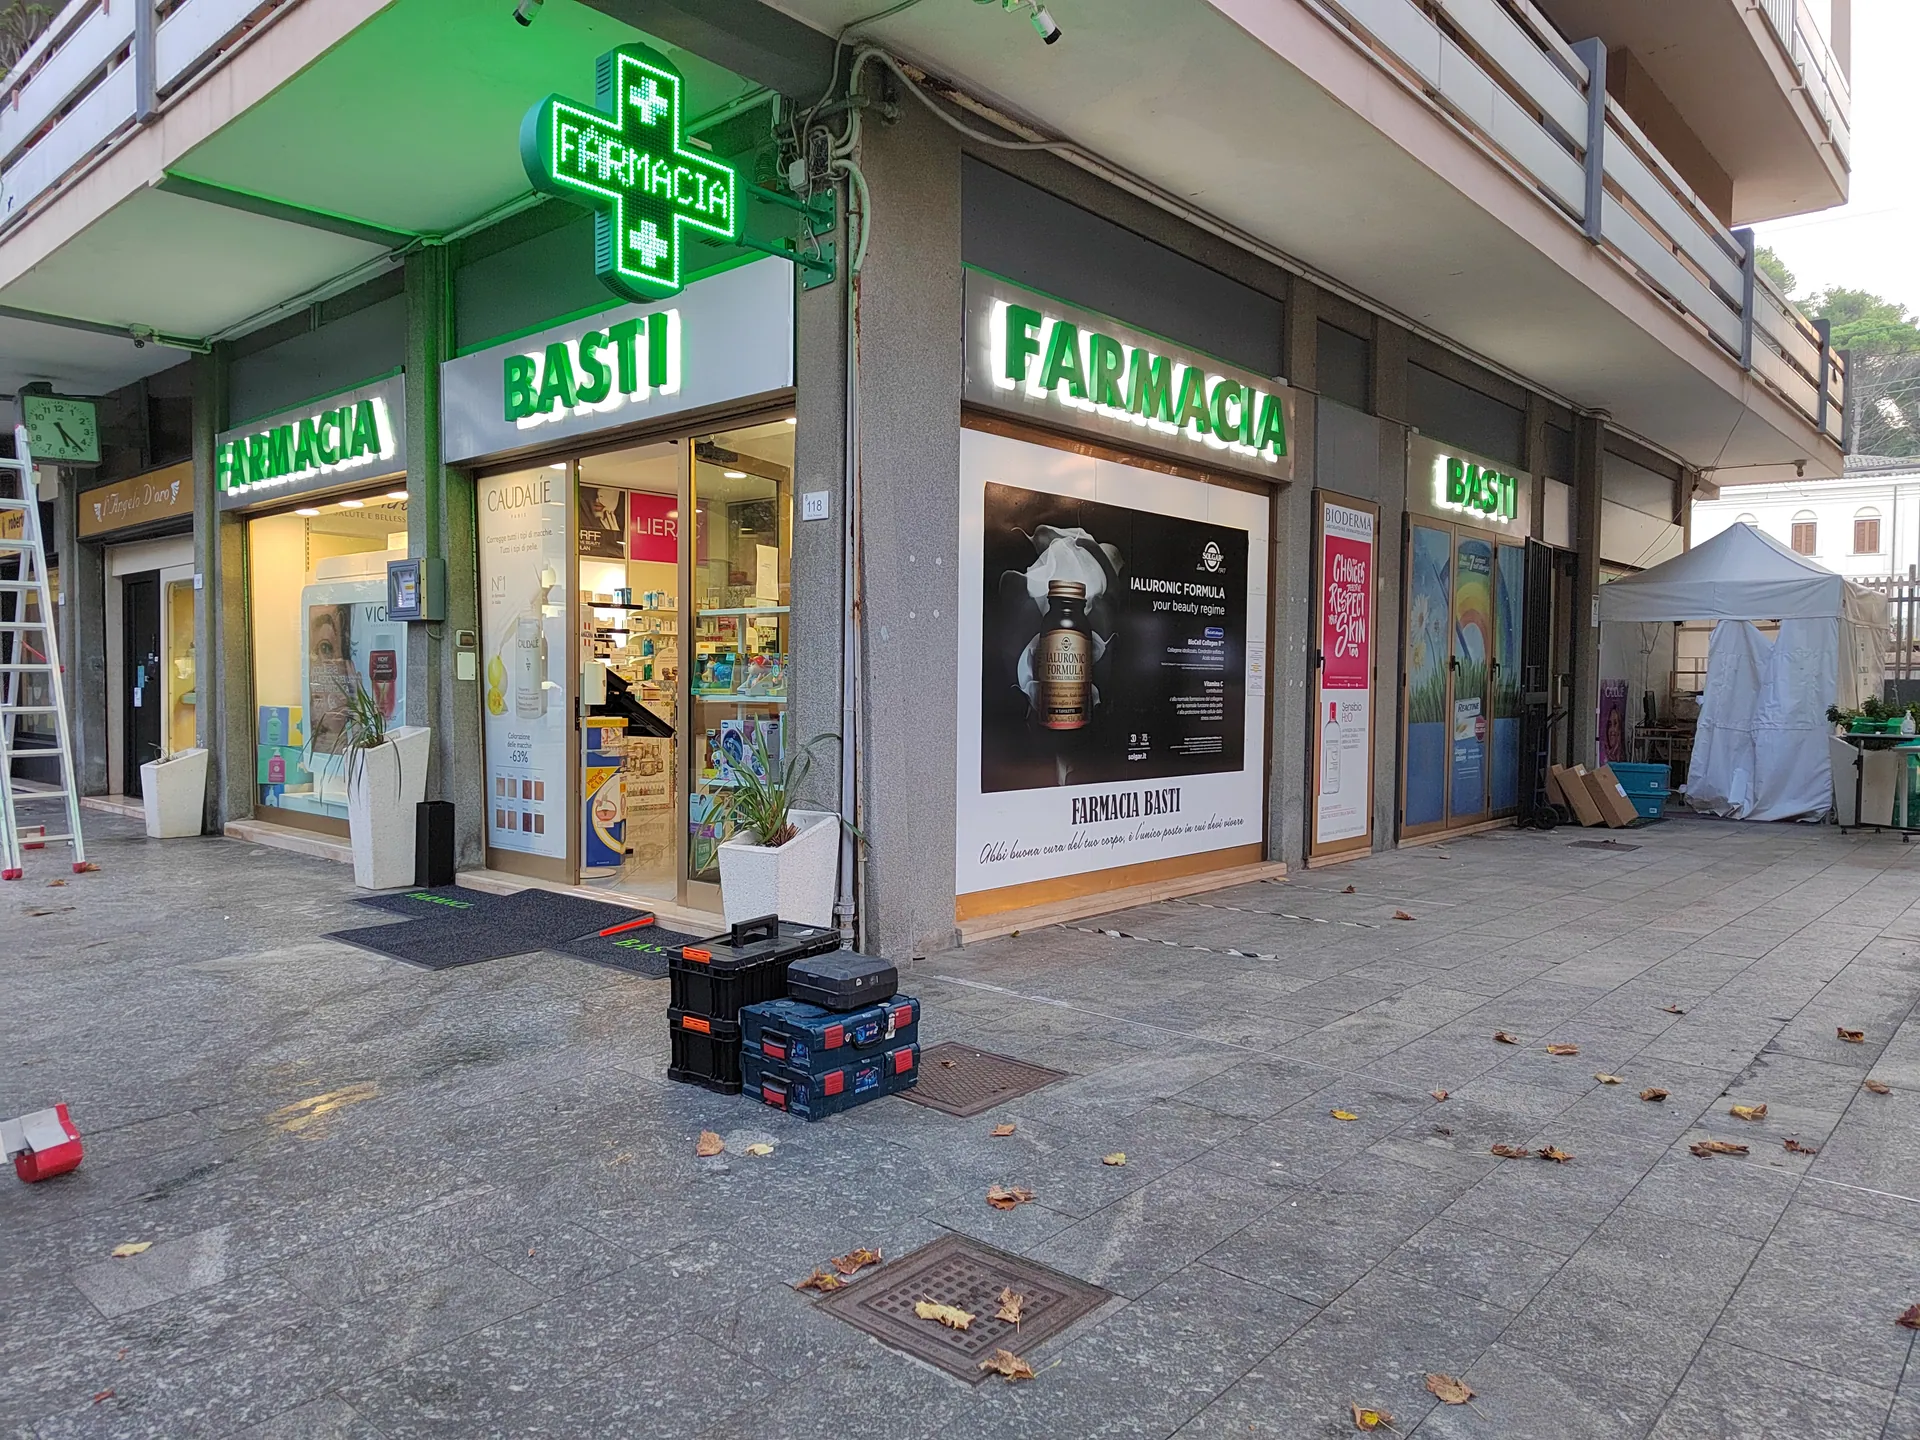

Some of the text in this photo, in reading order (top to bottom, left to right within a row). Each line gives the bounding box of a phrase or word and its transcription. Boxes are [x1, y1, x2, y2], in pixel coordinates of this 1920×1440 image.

[561, 123, 729, 219] FARMACIA
[504, 312, 667, 422] BASTI
[1005, 303, 1288, 457] FARMACIA
[217, 400, 381, 492] FARMACIA
[1446, 458, 1517, 520] BASTI
[807, 499, 822, 512] 118
[1326, 507, 1372, 531] BIODERMA
[636, 516, 678, 540] LIER
[1333, 553, 1365, 584] CHOICES
[1130, 576, 1225, 599] IALURONIC FORMULA
[1329, 582, 1365, 617] RESPECT
[1152, 600, 1225, 616] your beauty regime
[1046, 652, 1086, 664] IALURONIC
[1047, 664, 1084, 675] FORMULA
[509, 750, 529, 763] -63%
[1071, 788, 1181, 826] FARMACIA BASTI
[979, 841, 1009, 864] Abbi
[1009, 839, 1042, 860] buona
[1043, 843, 1066, 855] cura
[1067, 830, 1086, 852] del
[1083, 836, 1101, 849] tuo
[1162, 826, 1183, 842] posto
[1183, 825, 1193, 834] in
[1194, 823, 1206, 832] cui
[1223, 817, 1245, 829] vivere
